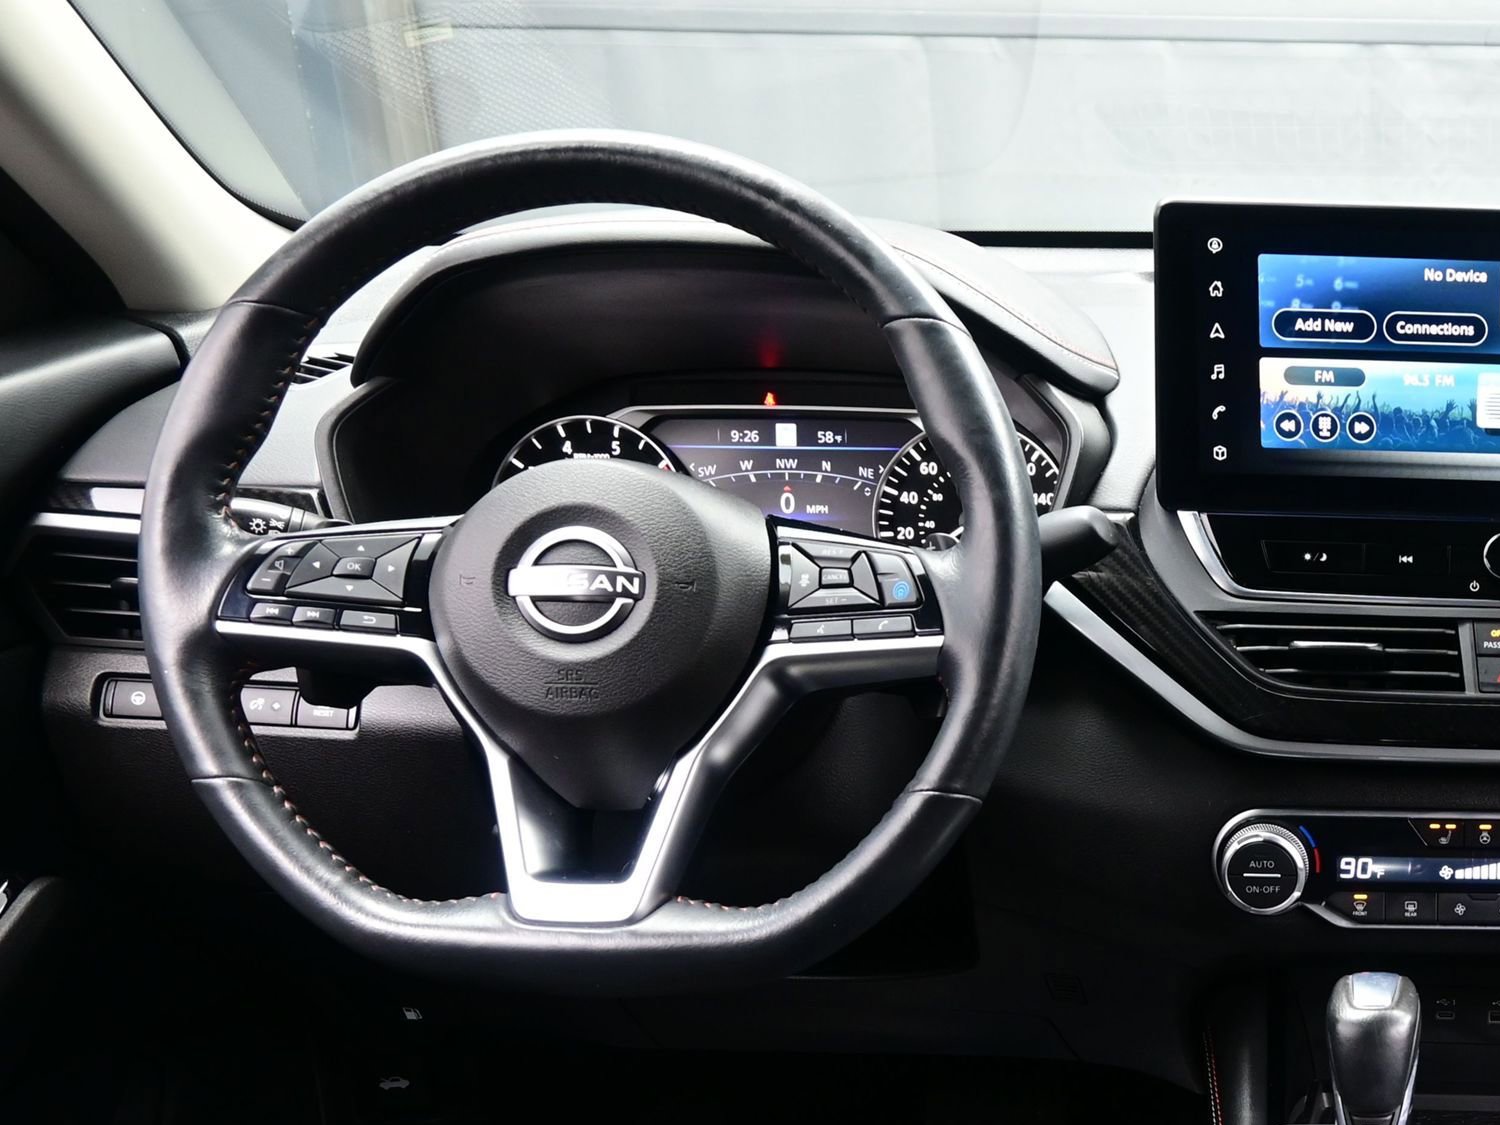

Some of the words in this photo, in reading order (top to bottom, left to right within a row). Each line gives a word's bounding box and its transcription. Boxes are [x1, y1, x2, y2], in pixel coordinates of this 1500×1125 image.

[1424, 268, 1443, 281] No
[1446, 269, 1488, 283] Device
[1295, 319, 1321, 332] Add
[1325, 320, 1354, 333] New
[1396, 321, 1475, 337] Connections
[1315, 370, 1335, 383] FM
[1435, 375, 1455, 387] FM
[730, 430, 760, 443] 9:26
[561, 441, 573, 456] 4
[611, 441, 621, 456] 5
[697, 464, 717, 478] SW
[740, 460, 754, 472] W
[776, 459, 798, 470] NW
[821, 460, 832, 472] N
[919, 462, 938, 475] 60
[858, 466, 875, 479] NE
[779, 492, 796, 515] 0
[899, 491, 918, 504] 40
[932, 493, 944, 502] 80
[806, 505, 829, 515] MPH
[924, 520, 936, 529] 40
[897, 527, 915, 540] 20
[346, 563, 361, 571] OK
[1483, 641, 1500, 649] PASS
[1249, 860, 1275, 869] AUTO
